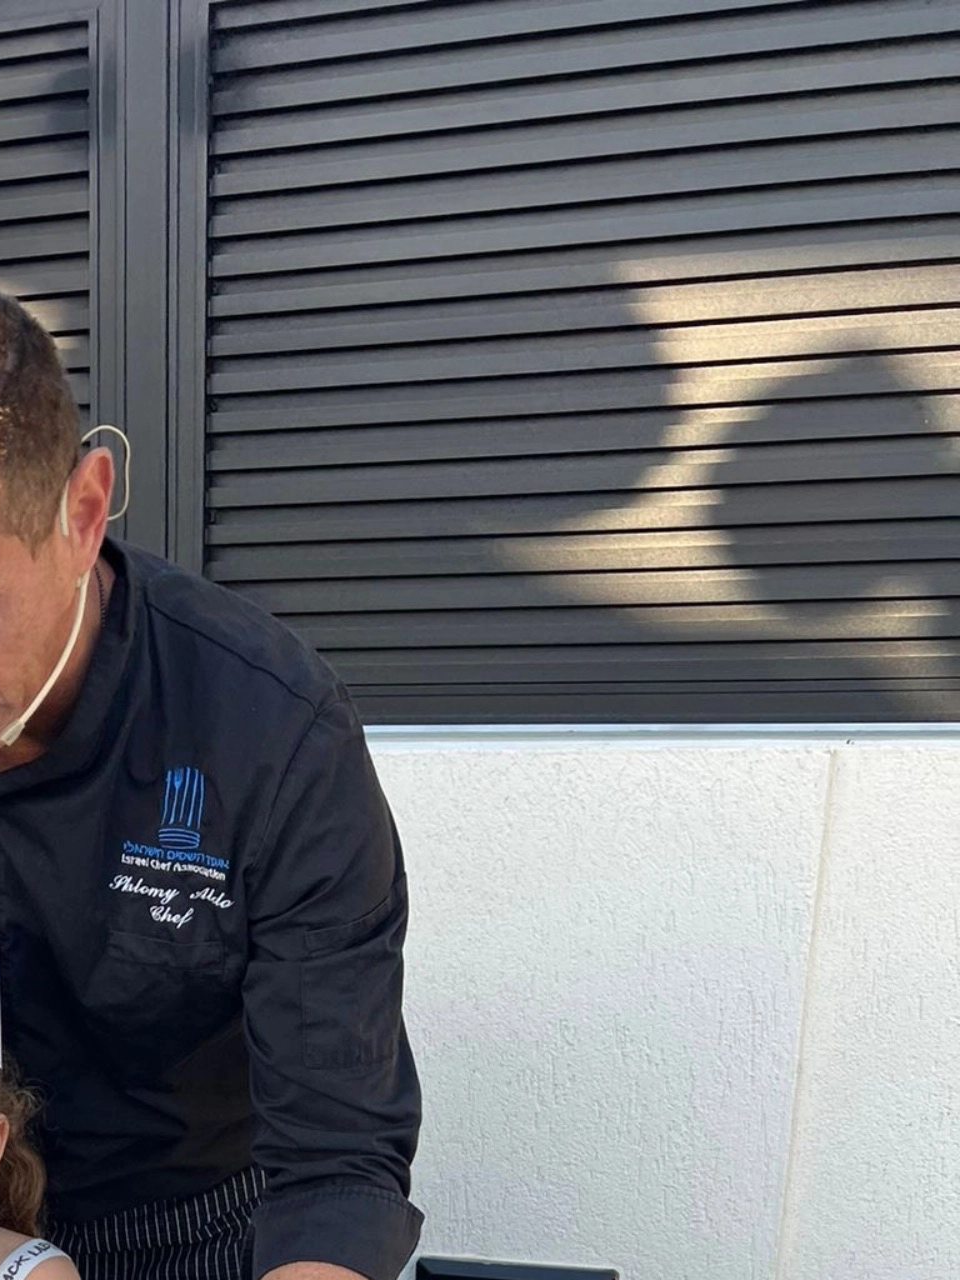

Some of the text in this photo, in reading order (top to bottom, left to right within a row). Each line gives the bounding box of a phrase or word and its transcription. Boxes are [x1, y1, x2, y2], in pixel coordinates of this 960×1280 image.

[120, 853, 226, 881] Israel Chef Association
[109, 874, 180, 905] Shlomy
[150, 905, 194, 929] Chef
